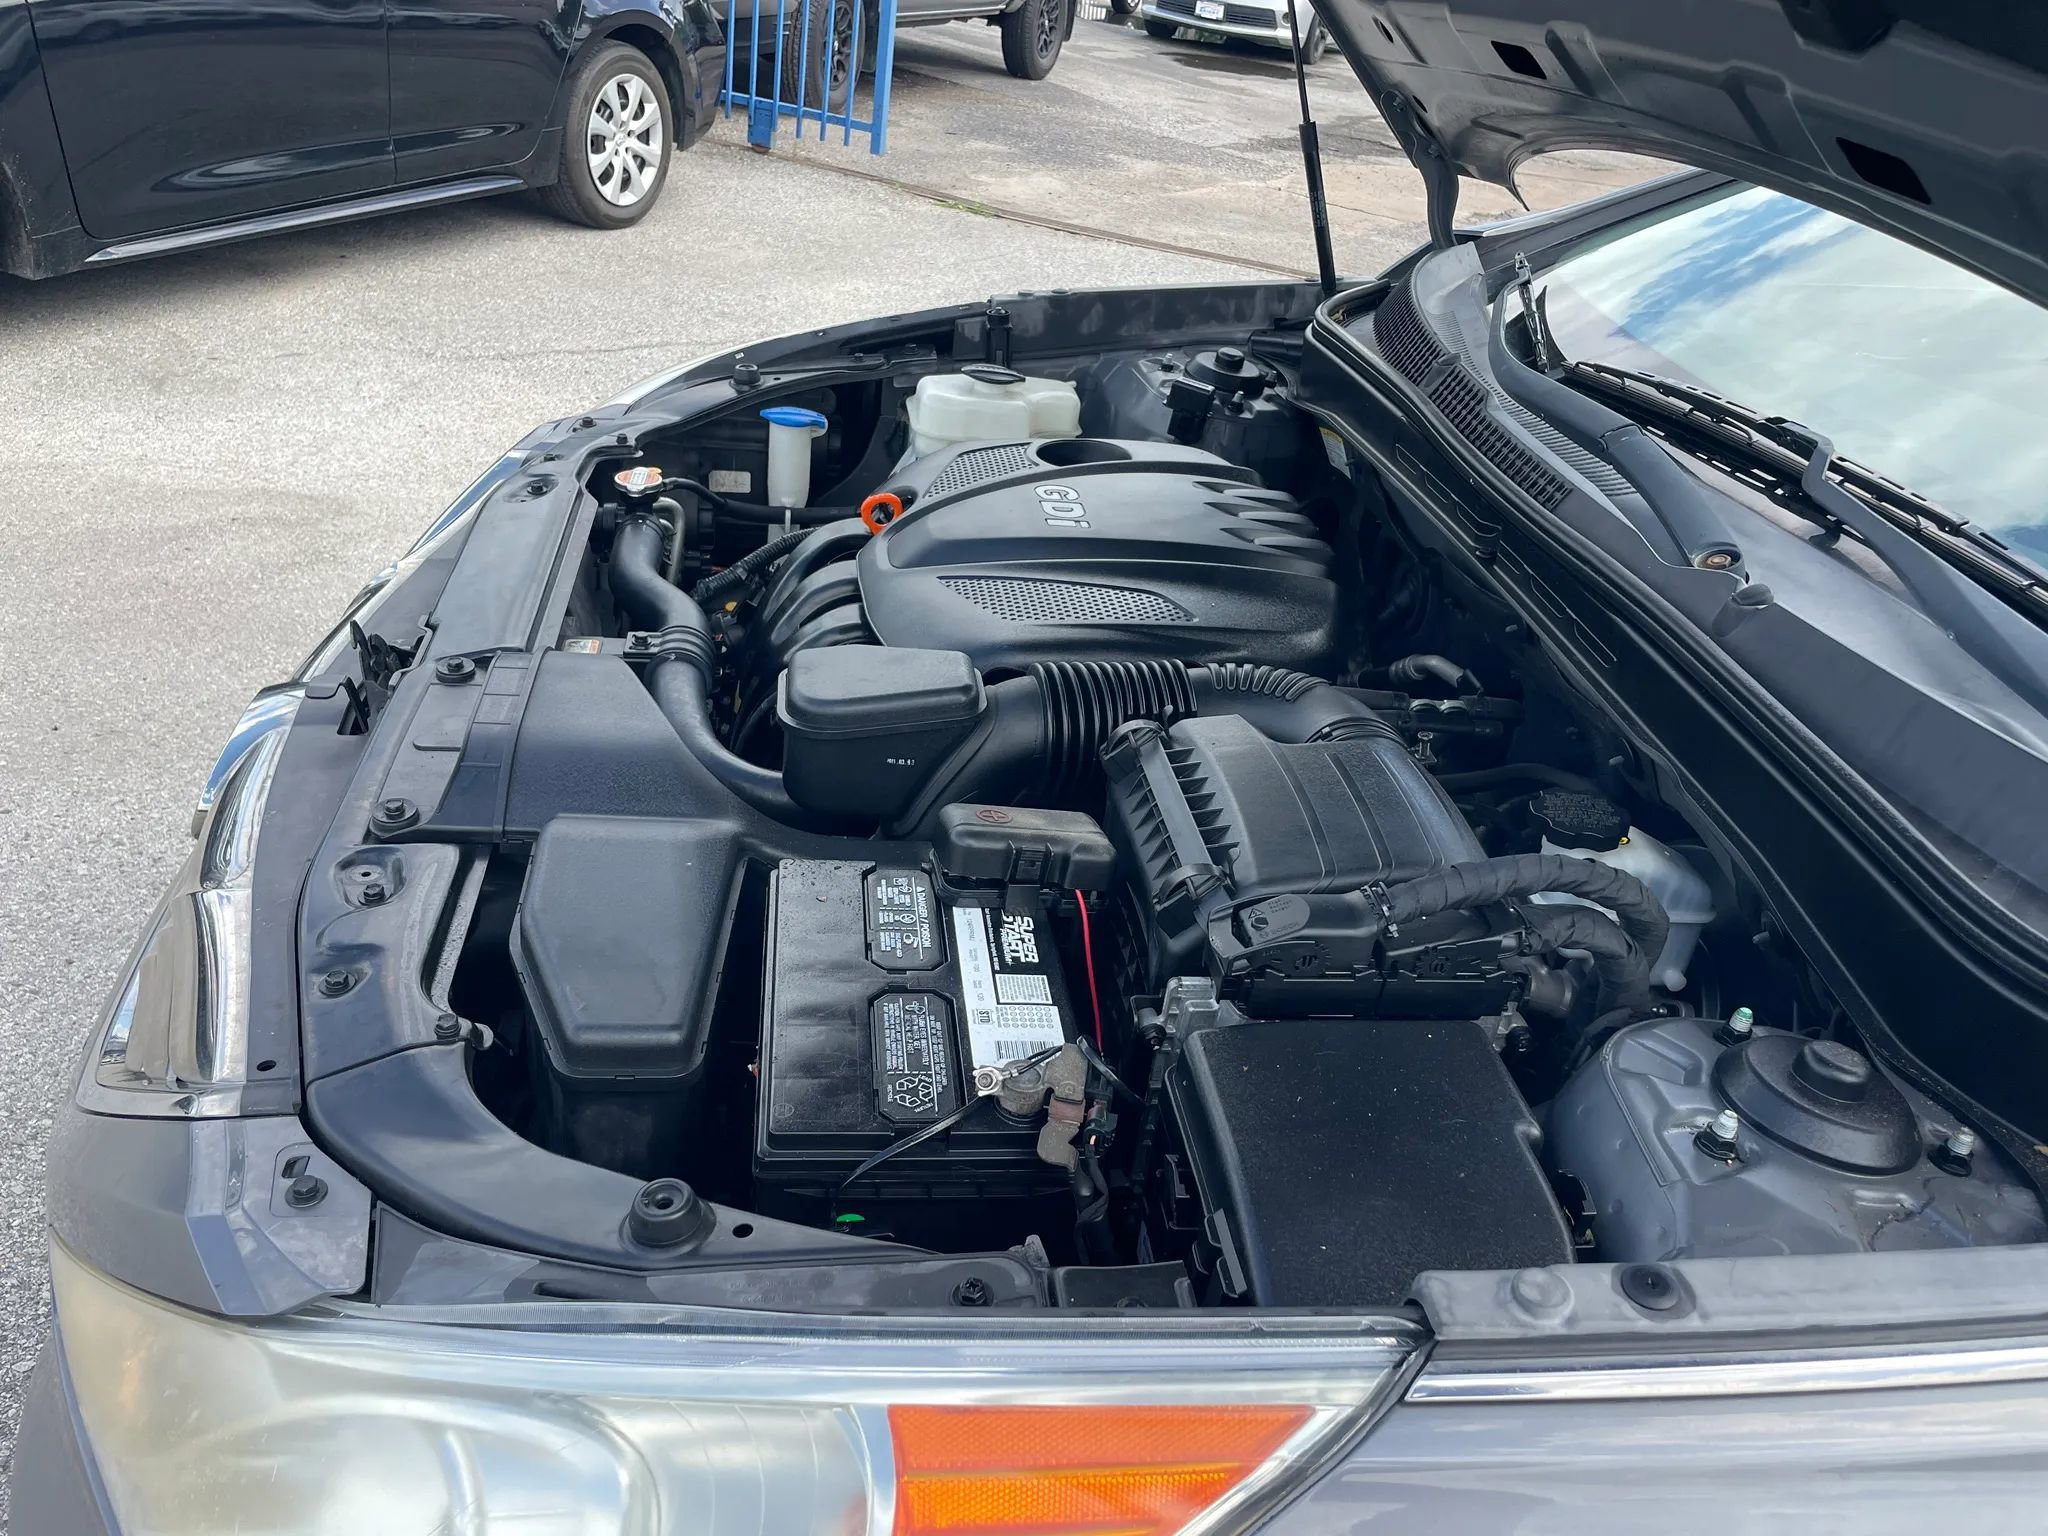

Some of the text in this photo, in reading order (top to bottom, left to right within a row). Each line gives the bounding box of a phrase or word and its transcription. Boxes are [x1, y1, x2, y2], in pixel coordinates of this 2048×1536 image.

[1034, 485, 1092, 528] GDi
[917, 892, 928, 917] DANGER
[920, 923, 932, 948] POISON
[1001, 913, 1026, 963] START
[1019, 917, 1039, 963] SUPER
[979, 1010, 991, 1023] STD
[913, 1040, 921, 1049] GET
[919, 1028, 927, 1038] EYES
